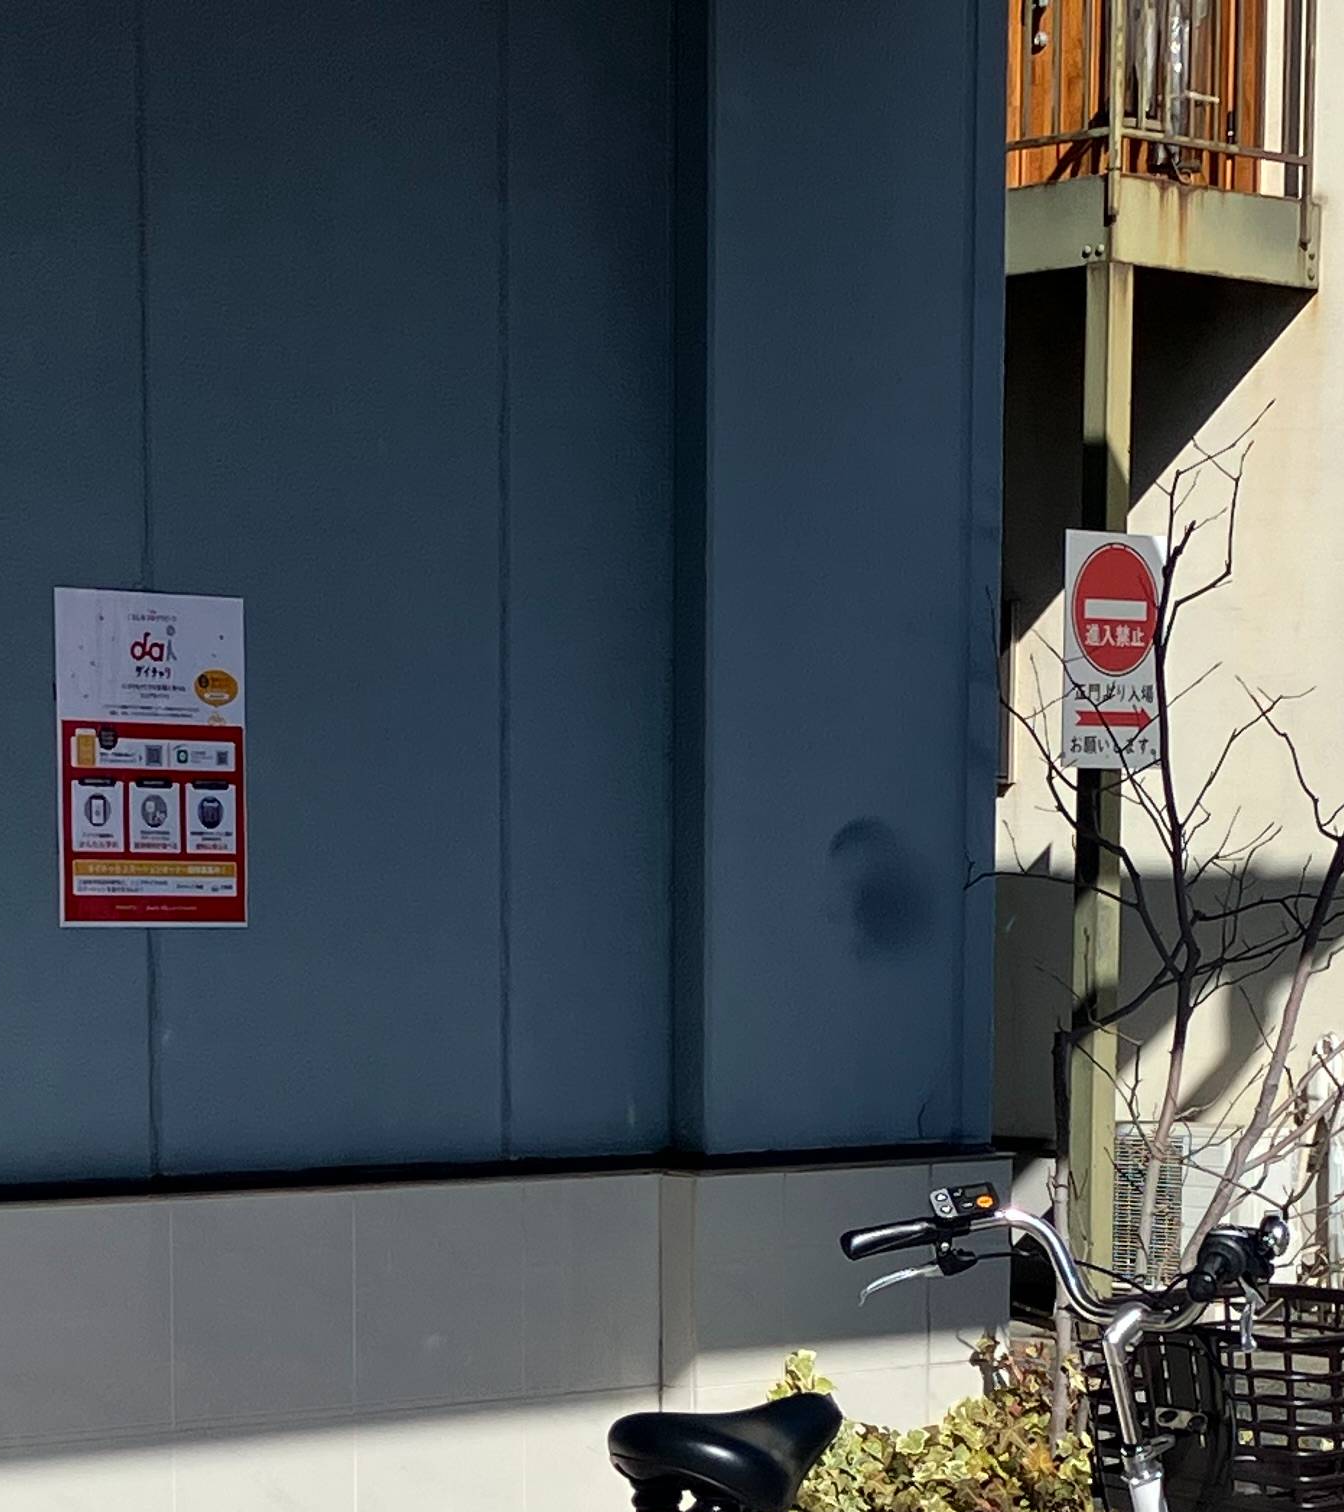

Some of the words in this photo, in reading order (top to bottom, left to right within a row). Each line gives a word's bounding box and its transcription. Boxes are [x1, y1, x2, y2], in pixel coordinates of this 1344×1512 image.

[1084, 623, 1146, 648] 進入禁止
[1074, 683, 1154, 704] 正門より入場
